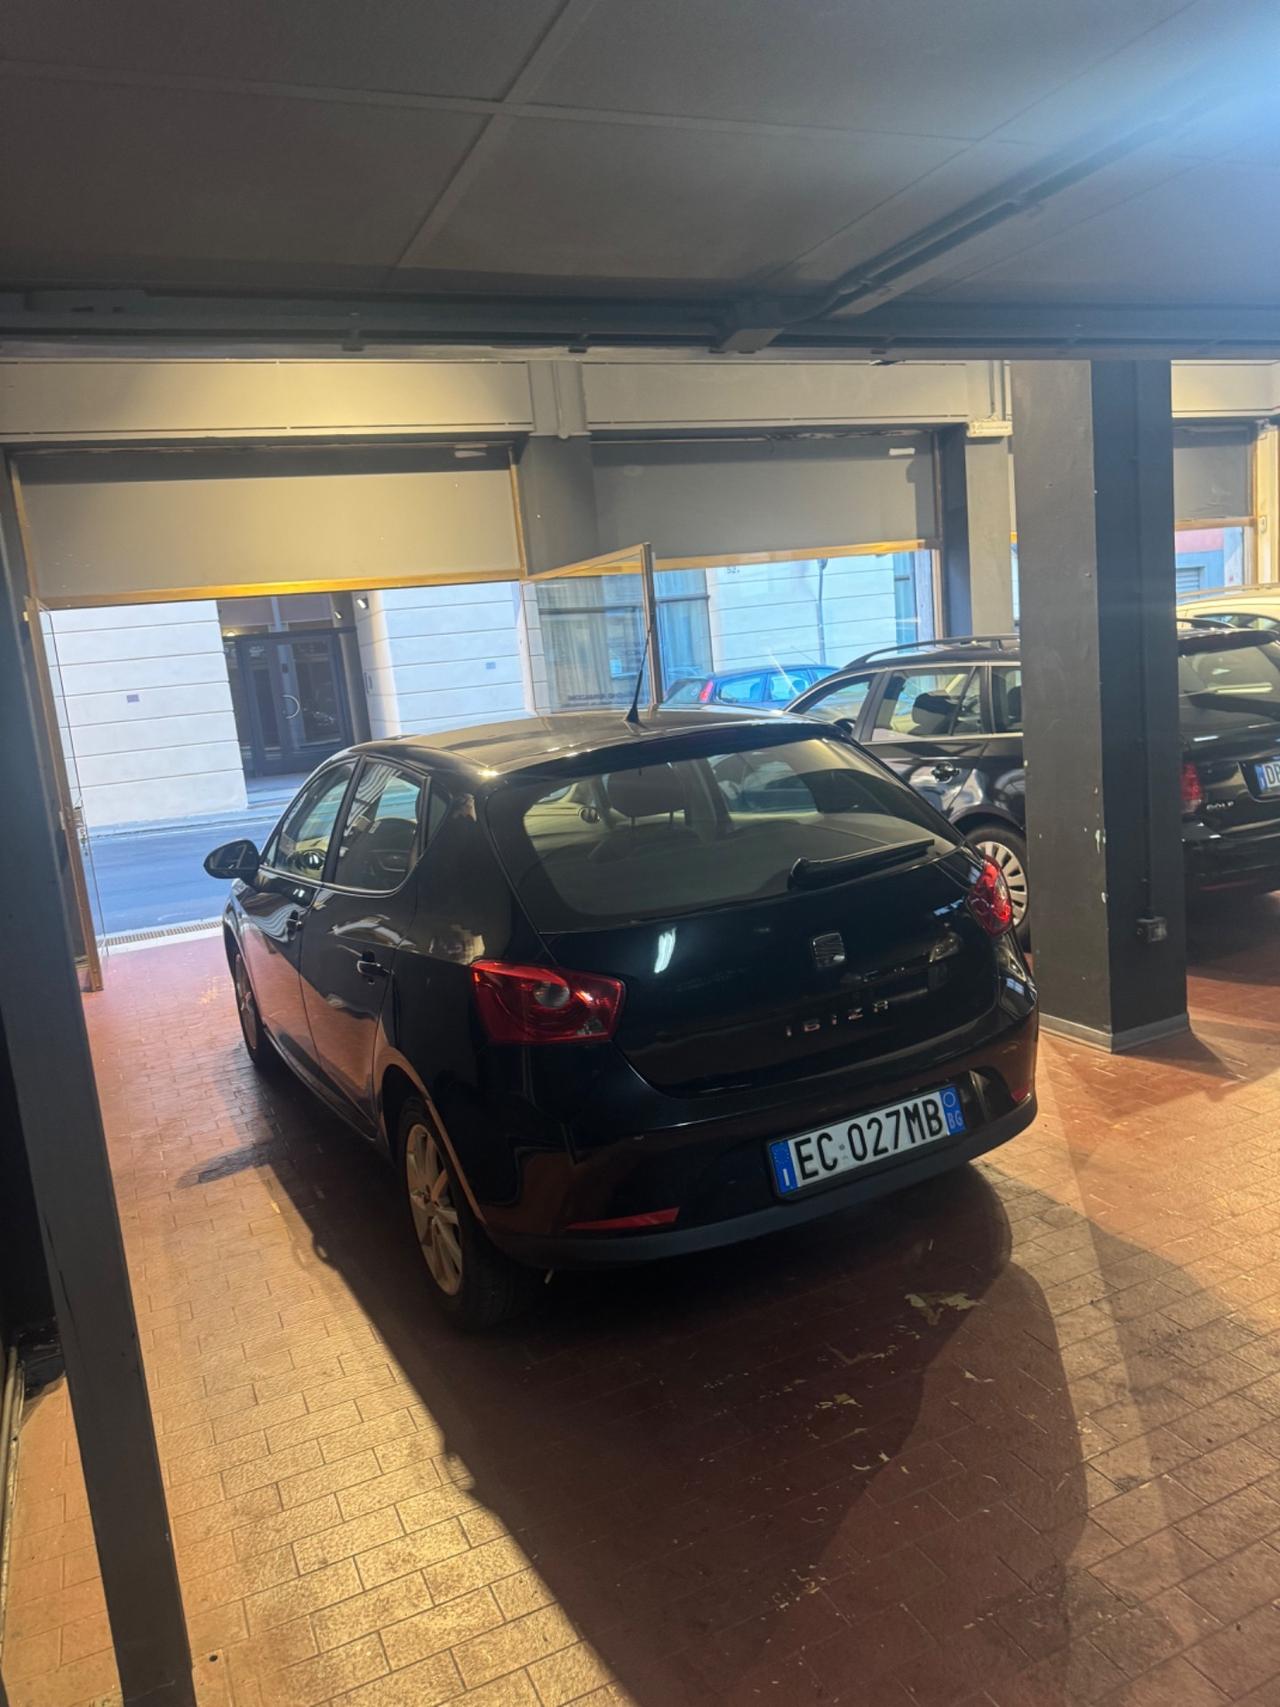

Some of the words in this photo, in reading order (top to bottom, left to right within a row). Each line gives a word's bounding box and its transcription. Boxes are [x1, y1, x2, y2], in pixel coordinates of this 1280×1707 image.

[785, 1000, 889, 1036] IBIZA
[947, 1110, 964, 1129] BG
[794, 1131, 838, 1181] EC
[847, 1099, 944, 1162] 027MB
